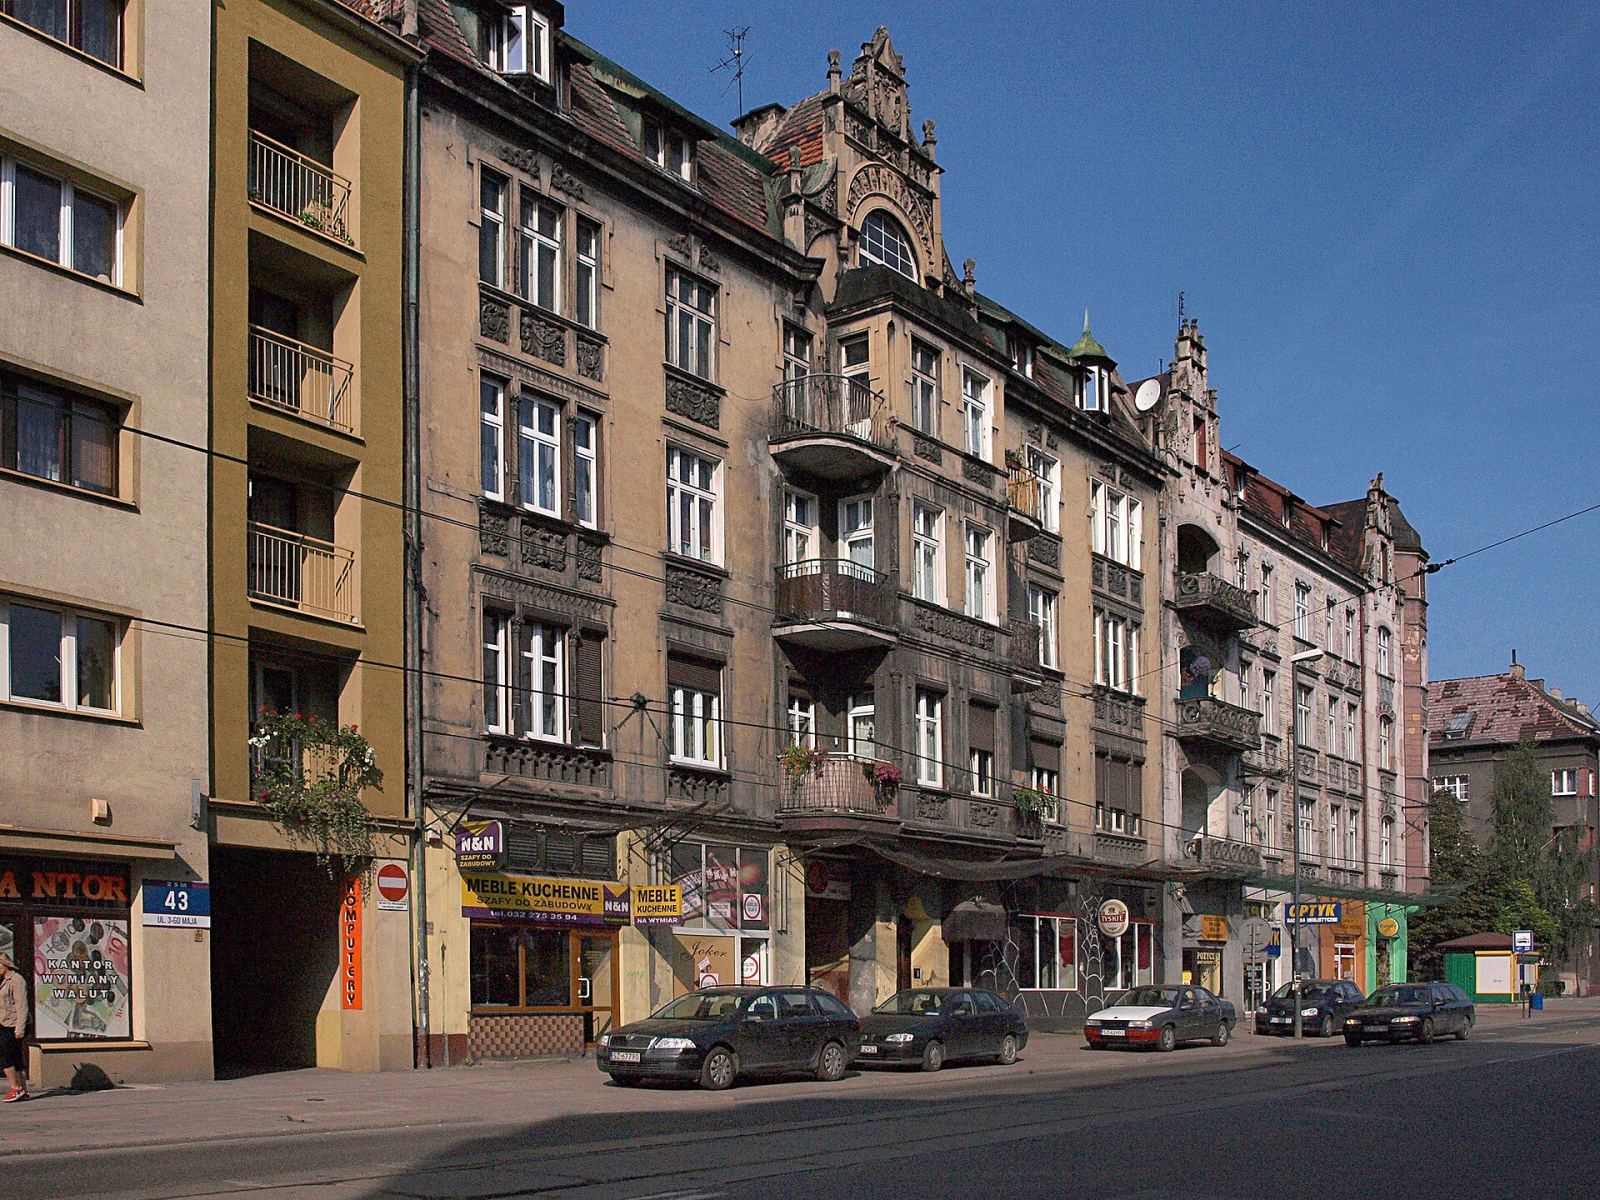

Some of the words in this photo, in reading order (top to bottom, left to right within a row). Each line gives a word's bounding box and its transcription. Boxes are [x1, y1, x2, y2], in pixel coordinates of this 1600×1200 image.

[461, 836, 494, 851] N&N
[467, 878, 517, 895] MEBLE
[522, 883, 599, 901] KUCHENNE
[638, 889, 677, 902] MEBLE
[164, 890, 188, 911] 43
[477, 896, 512, 906] SZAFY
[515, 898, 531, 907] DO
[534, 900, 593, 911] ZABUDOWY
[605, 901, 629, 913] N&N
[637, 904, 678, 913] KUCHENNE
[182, 917, 198, 925] MAJA
[1101, 914, 1124, 922] TYSKIE
[681, 941, 728, 959] Joker
[48, 960, 113, 970] KANTOR
[42, 975, 118, 984] WYMIANY
[53, 989, 108, 998] WALUT
